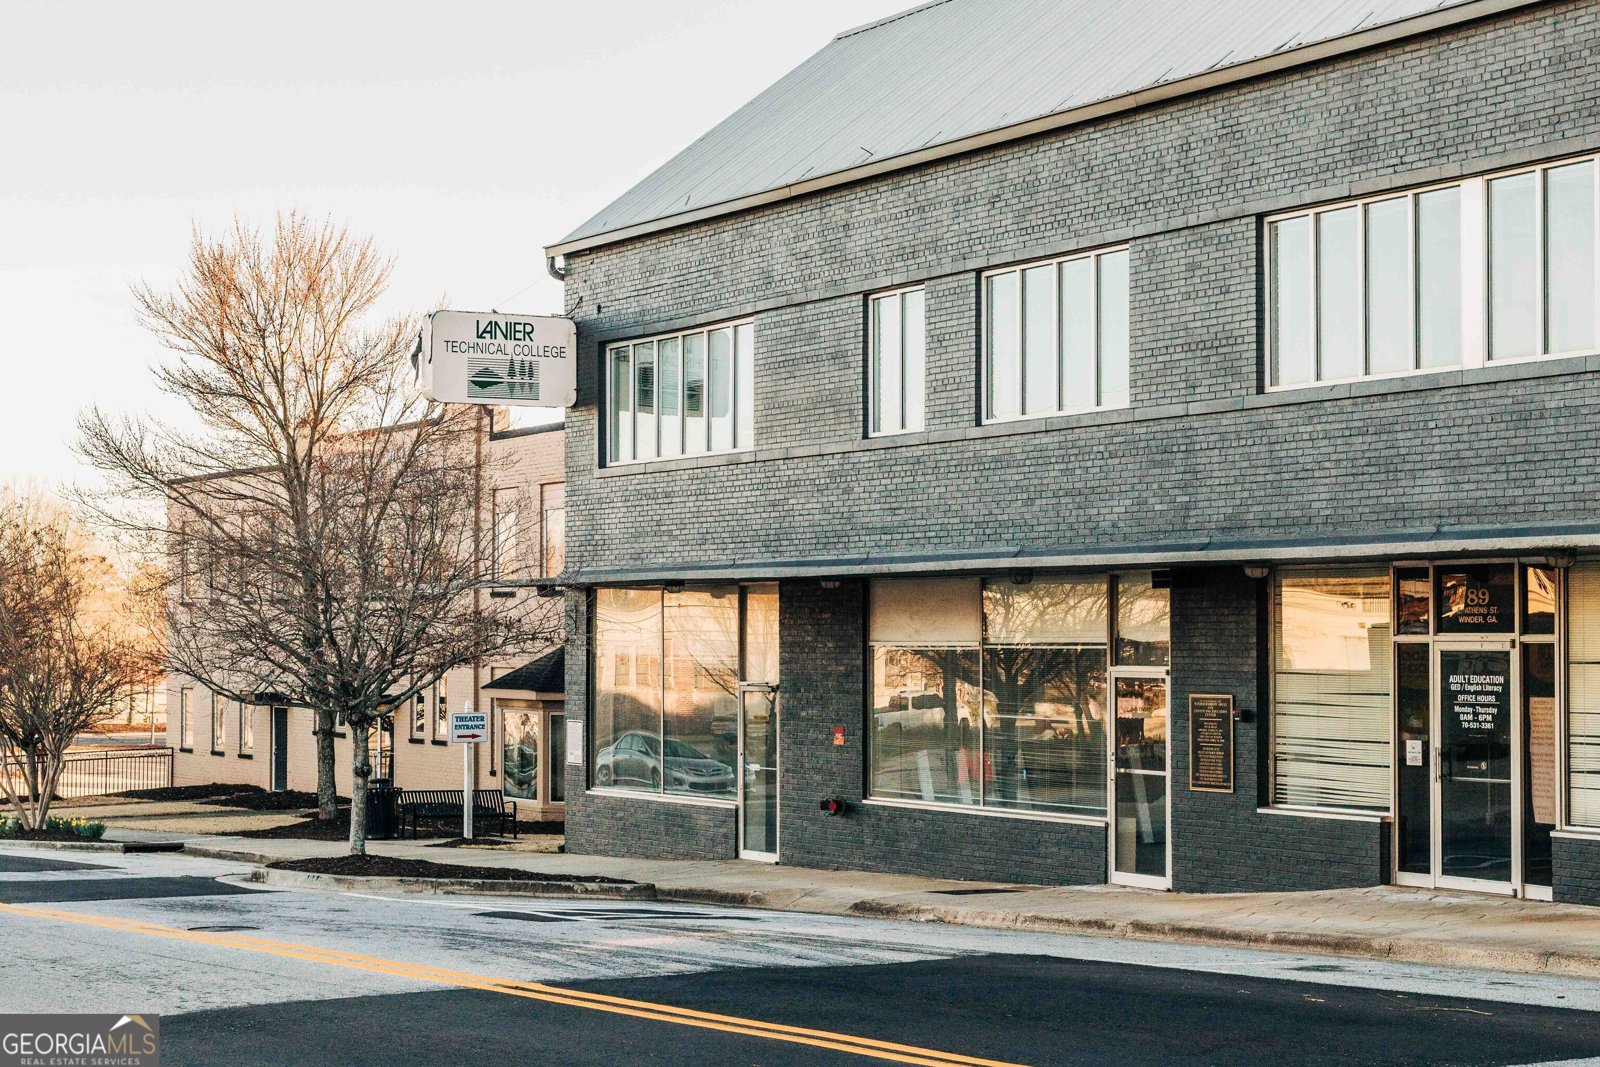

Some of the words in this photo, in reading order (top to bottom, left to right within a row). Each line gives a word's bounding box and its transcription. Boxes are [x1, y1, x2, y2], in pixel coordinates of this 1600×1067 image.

[476, 319, 535, 342] LANIER
[444, 340, 509, 356] TECHNICAL
[513, 343, 567, 359] COLLEGE
[1467, 588, 1490, 605] 89
[1464, 606, 1488, 614] ATHENS
[1449, 674, 1469, 683] ADULT
[1470, 675, 1504, 684] EDUCATION
[1465, 684, 1482, 692] English
[1482, 684, 1502, 693] Literacy
[1457, 694, 1476, 702] OFFICE
[1459, 713, 1473, 721] 8AM
[1478, 714, 1492, 722] 6PM
